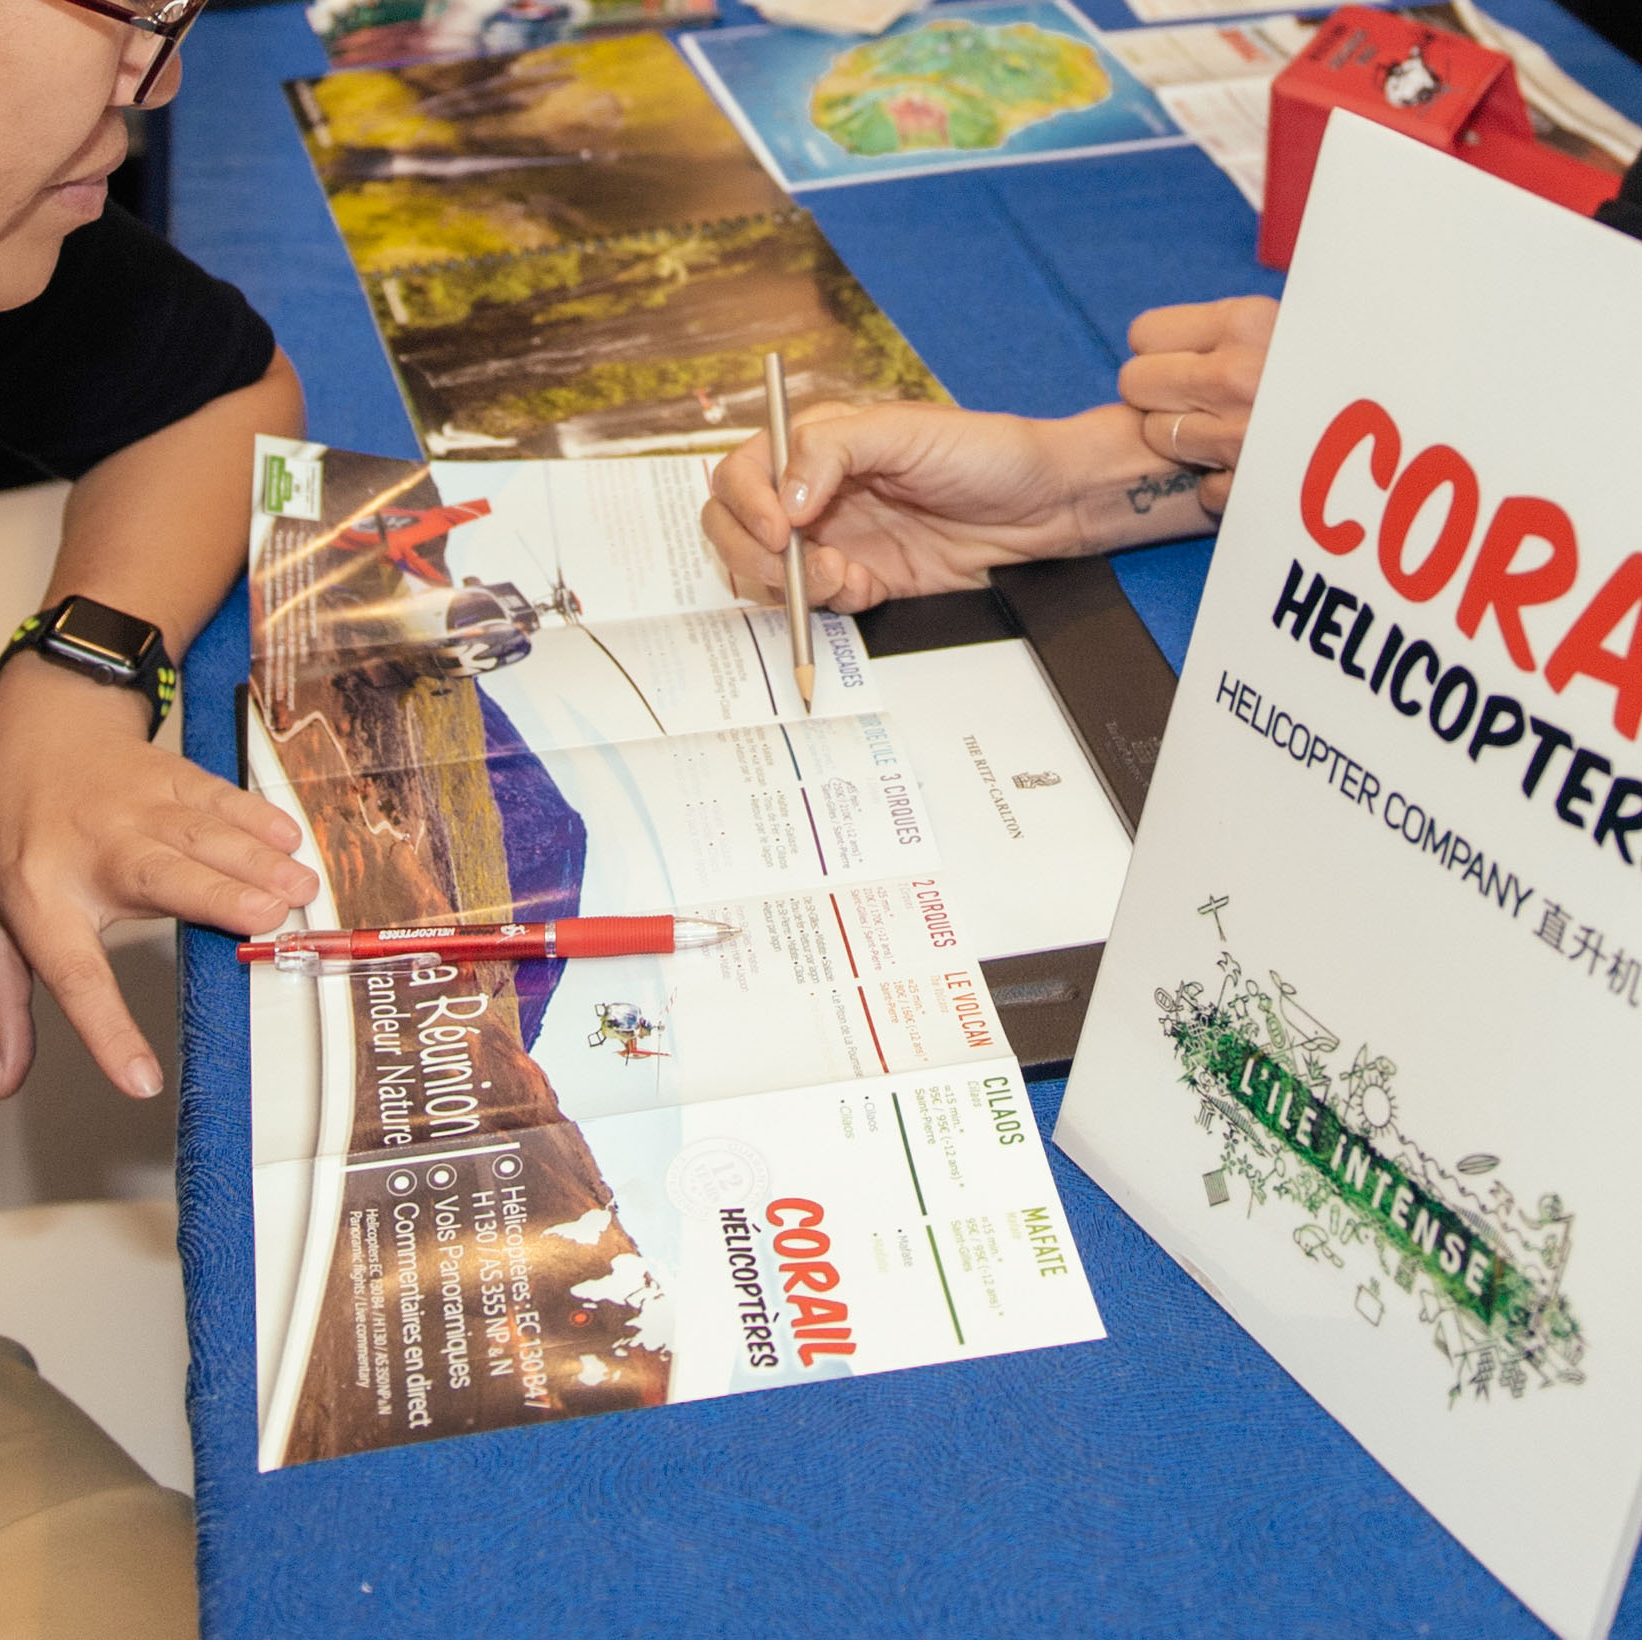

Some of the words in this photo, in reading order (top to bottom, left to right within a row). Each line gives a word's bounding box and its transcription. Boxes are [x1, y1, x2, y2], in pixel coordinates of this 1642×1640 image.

[829, 639, 865, 689] CASCADES
[963, 733, 984, 757] THE
[880, 773, 903, 782] 3
[1217, 670, 1381, 815] HELICOPTER
[1383, 791, 1535, 918] COMPANY
[884, 785, 922, 846] CIRQUES
[972, 758, 1025, 840] RITZ-CARLTON
[832, 826, 852, 870] Saint-Pierre
[912, 879, 935, 888] 2
[915, 891, 957, 949] CIRQUES
[863, 930, 883, 971] Saint-Pierre
[944, 971, 973, 989] LE
[879, 982, 900, 1024] Saint-Pierre
[951, 993, 994, 1048] VOLCAN
[415, 992, 490, 1138] Réunion
[376, 1065, 416, 1145] Nature
[928, 1085, 943, 1105] 95€
[967, 1080, 982, 1108] Cilaos
[983, 1076, 1025, 1145] CILAOS
[863, 1101, 879, 1133] Cilaos
[913, 1088, 936, 1145] Saint-Pierre
[935, 1113, 951, 1133] 95€
[940, 1135, 957, 1157] (-12
[948, 1159, 963, 1180] ans)
[433, 1194, 462, 1243] Vols
[471, 1190, 496, 1208] H
[350, 1210, 367, 1264] Panoramic
[364, 1208, 382, 1263] Helicopters
[474, 1209, 500, 1243] 130
[500, 1185, 532, 1303] Hélicoptères
[950, 1219, 974, 1273] Saint-Gilles
[1021, 1207, 1068, 1277] MAFATE
[479, 1258, 504, 1283] AS
[897, 1234, 915, 1268] Mafate
[393, 1201, 426, 1345] Commentaires
[719, 1207, 780, 1368] HÉLICOPTÈRES
[766, 1197, 857, 1368] CORAIL
[355, 1302, 370, 1324] Live
[439, 1244, 474, 1390] Panoramiques
[481, 1283, 507, 1316] 355
[484, 1316, 511, 1344] NP
[516, 1311, 542, 1336] EC
[355, 1324, 372, 1389] commentary
[403, 1346, 426, 1371] en
[489, 1359, 515, 1377] N
[517, 1339, 545, 1373] 130
[405, 1373, 434, 1430] direct
[521, 1373, 549, 1399] B4
